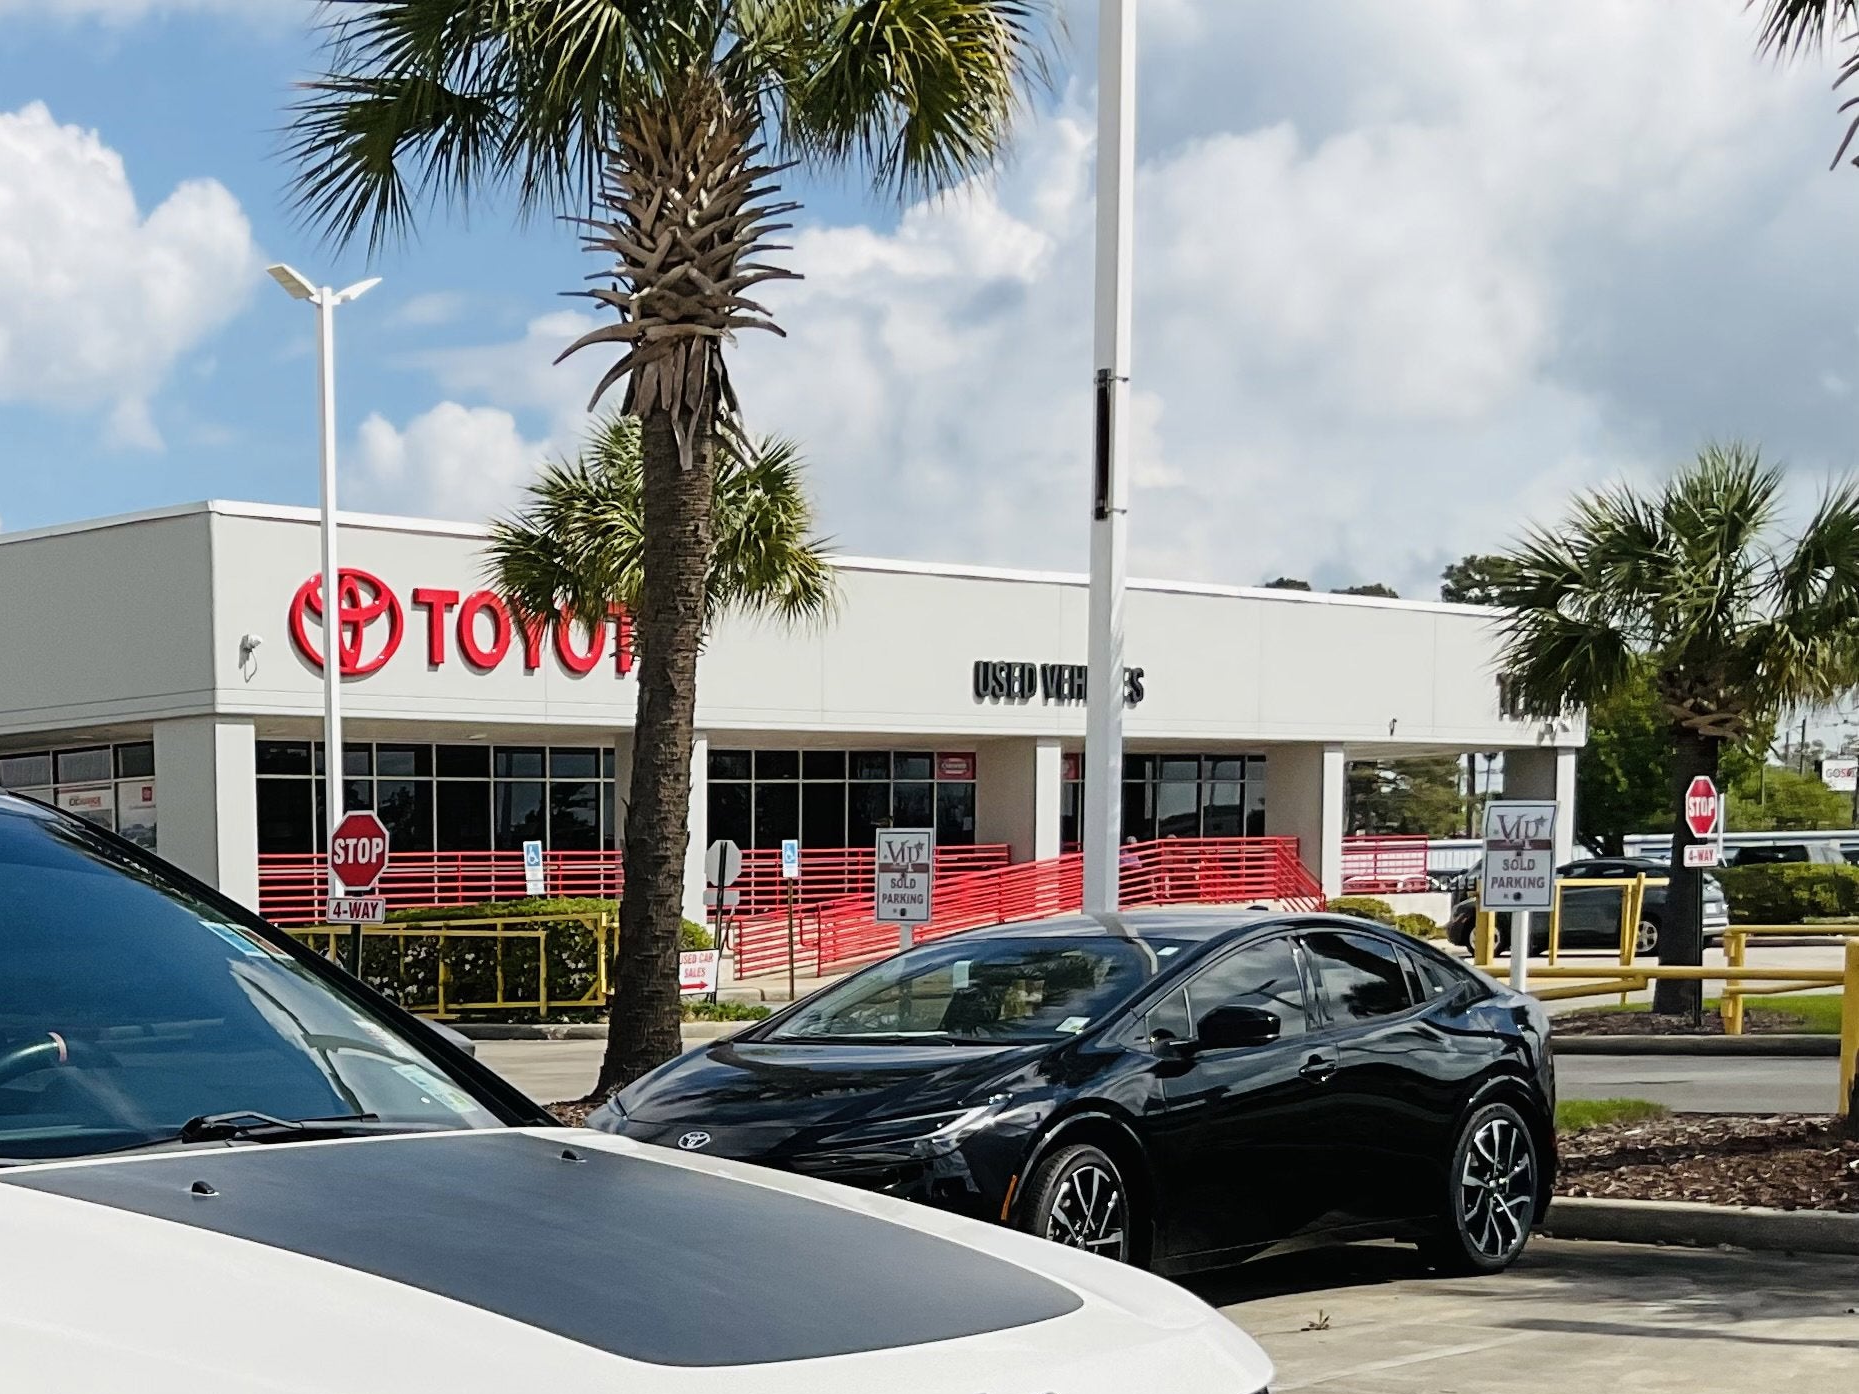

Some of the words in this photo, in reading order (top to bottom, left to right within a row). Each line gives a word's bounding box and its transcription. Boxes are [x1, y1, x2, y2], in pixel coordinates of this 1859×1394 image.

[413, 587, 635, 674] TOYOT
[973, 660, 1038, 699] USED
[1040, 663, 1144, 704] VEHES
[1688, 796, 1715, 817] STOP
[333, 837, 384, 865] STOP
[1688, 849, 1714, 862] 4-WAY
[1502, 858, 1536, 871] SOLD
[890, 878, 917, 889] SOLD
[1491, 876, 1545, 889] PARKING
[882, 893, 924, 904] PARKING
[333, 901, 379, 919] 4-WAY
[699, 952, 714, 963] CAR
[684, 967, 706, 978] SALES
